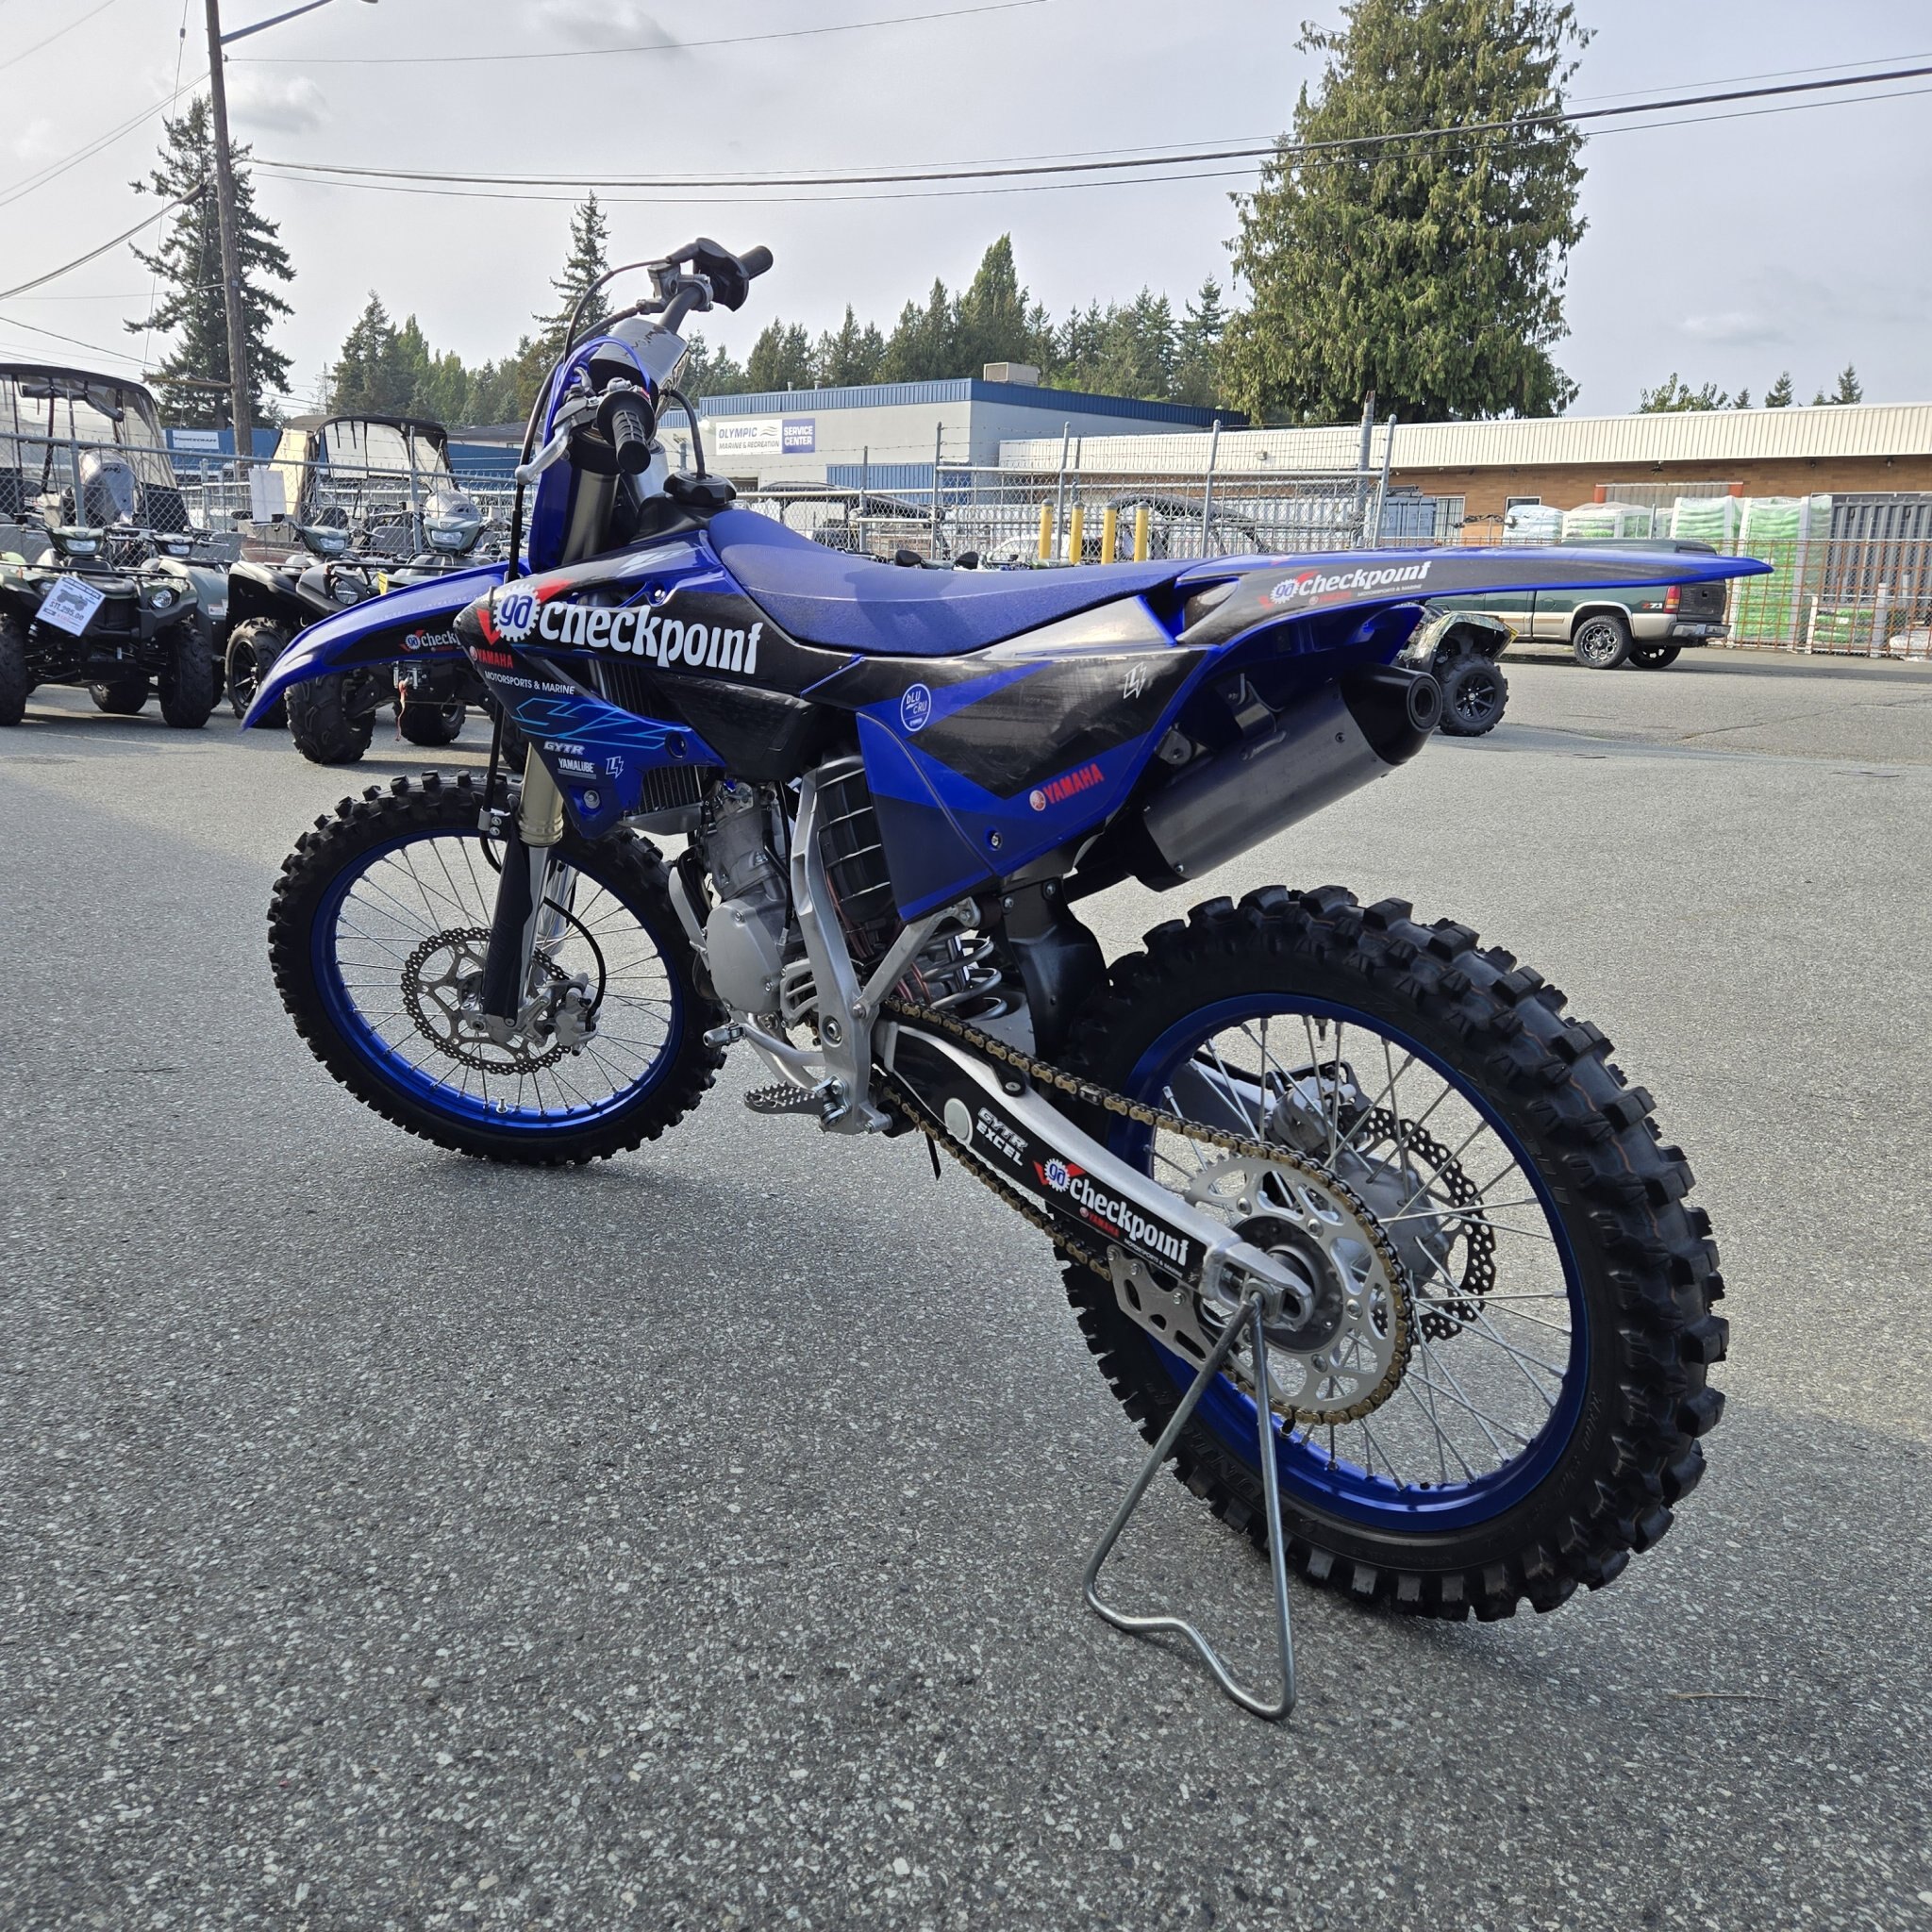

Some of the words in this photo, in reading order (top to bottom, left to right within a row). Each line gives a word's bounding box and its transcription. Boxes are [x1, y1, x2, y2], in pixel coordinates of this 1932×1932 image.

[719, 427, 758, 439] OLYMPIC
[784, 425, 813, 436] SERVICE
[784, 437, 812, 445] CENTER
[1298, 560, 1432, 596] checkpoint
[477, 649, 513, 669] YAMAHA
[484, 671, 533, 689] MOTORSPORTS
[533, 681, 541, 691] &
[542, 682, 575, 695] MARINE
[543, 741, 585, 755] GYTR
[558, 758, 594, 774] YAMALUBE
[1042, 763, 1105, 804] YAMAHA
[977, 1107, 1029, 1153] GYTR
[975, 1118, 1024, 1167] EXCEL
[1069, 1179, 1190, 1267] checkpoint
[1089, 1212, 1120, 1238] YAMAHA
